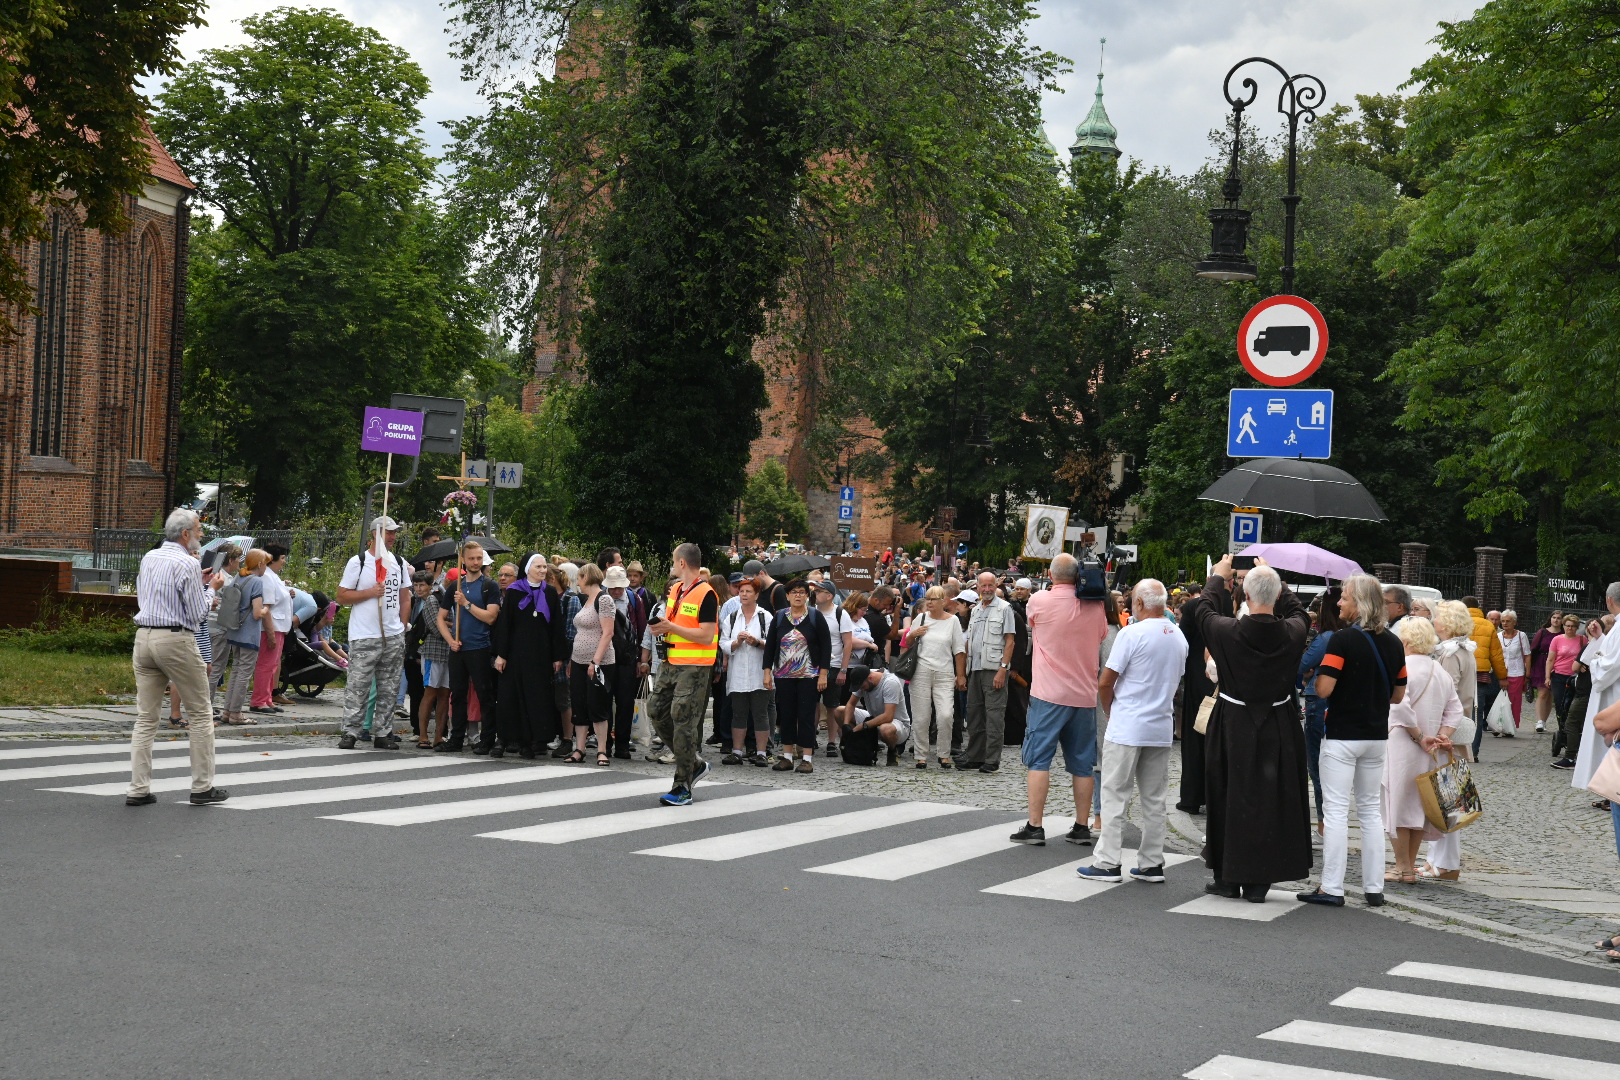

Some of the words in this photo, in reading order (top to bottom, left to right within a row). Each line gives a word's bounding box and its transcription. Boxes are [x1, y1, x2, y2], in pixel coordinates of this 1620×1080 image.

[387, 422, 414, 432] GRUPA
[384, 431, 416, 441] POKUTNA
[841, 507, 850, 518] P
[1238, 519, 1254, 540] P
[1548, 578, 1585, 591] RESTAURACJA
